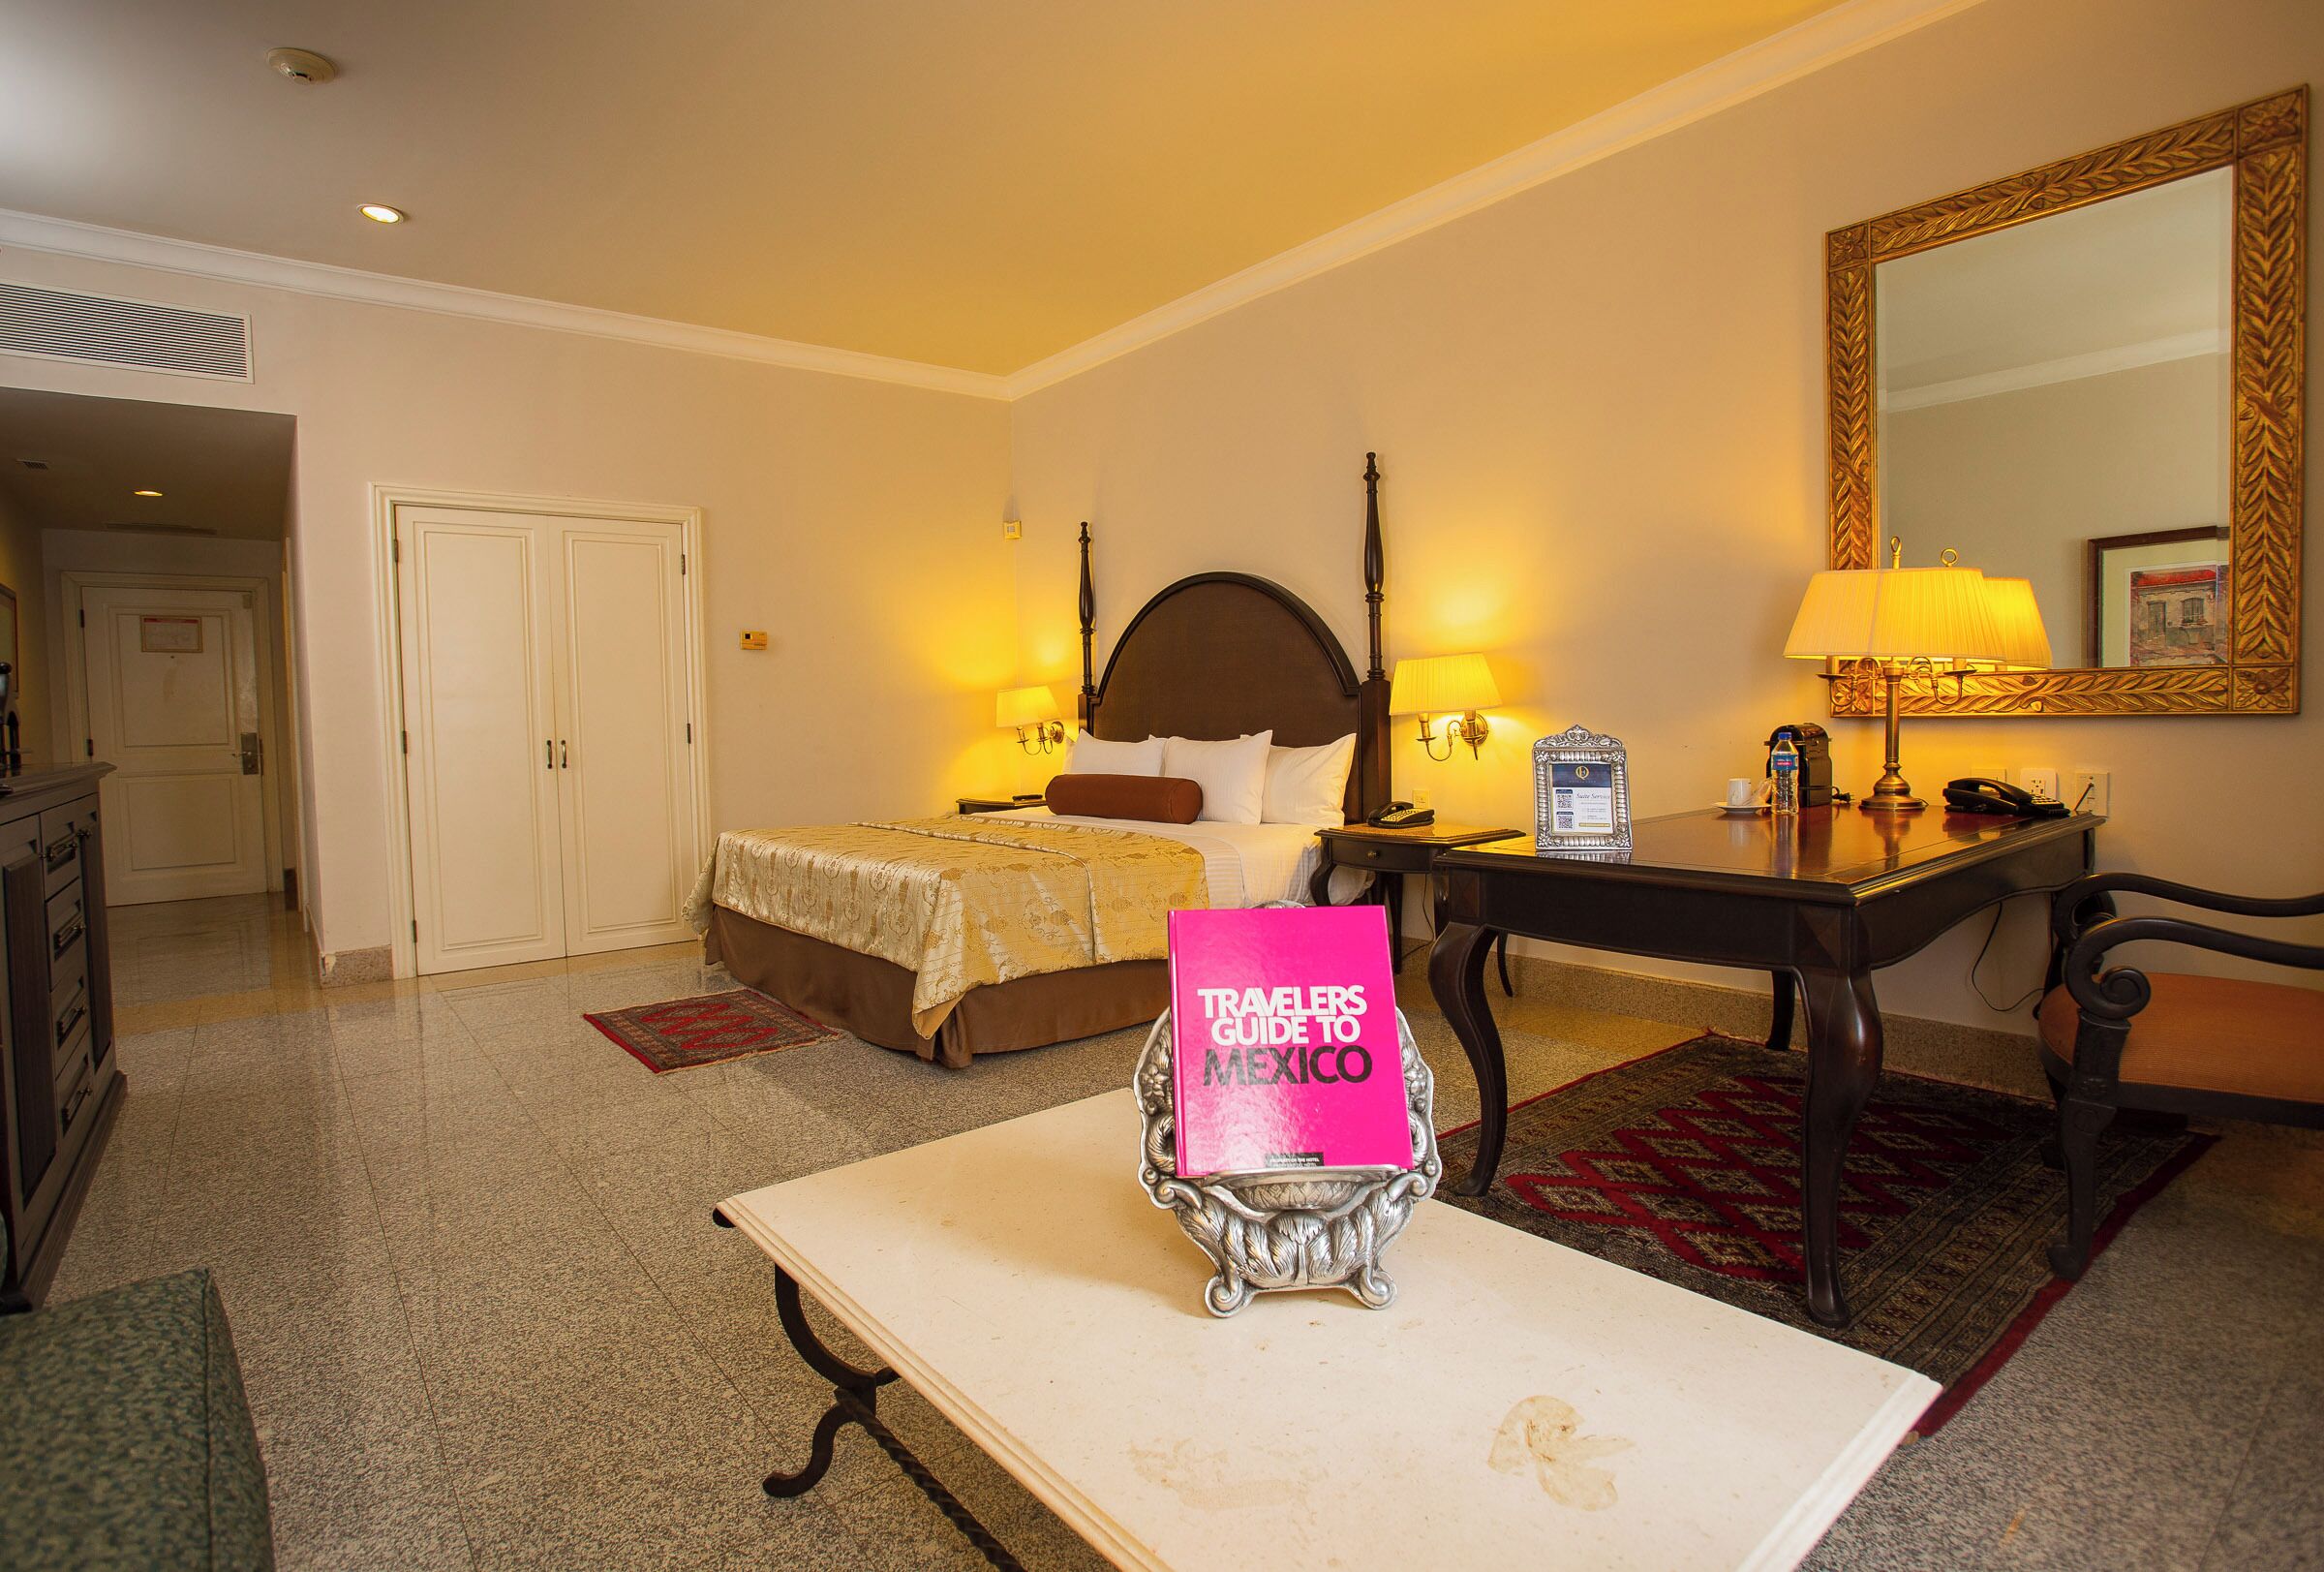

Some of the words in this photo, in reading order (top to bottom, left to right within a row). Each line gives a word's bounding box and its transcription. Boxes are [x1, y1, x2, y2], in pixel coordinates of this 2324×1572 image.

[1197, 985, 1368, 1018] TRAVELERS
[1210, 1016, 1309, 1046] GUIDE
[1315, 1015, 1361, 1043] TO
[1204, 1045, 1373, 1087] MEXICO
